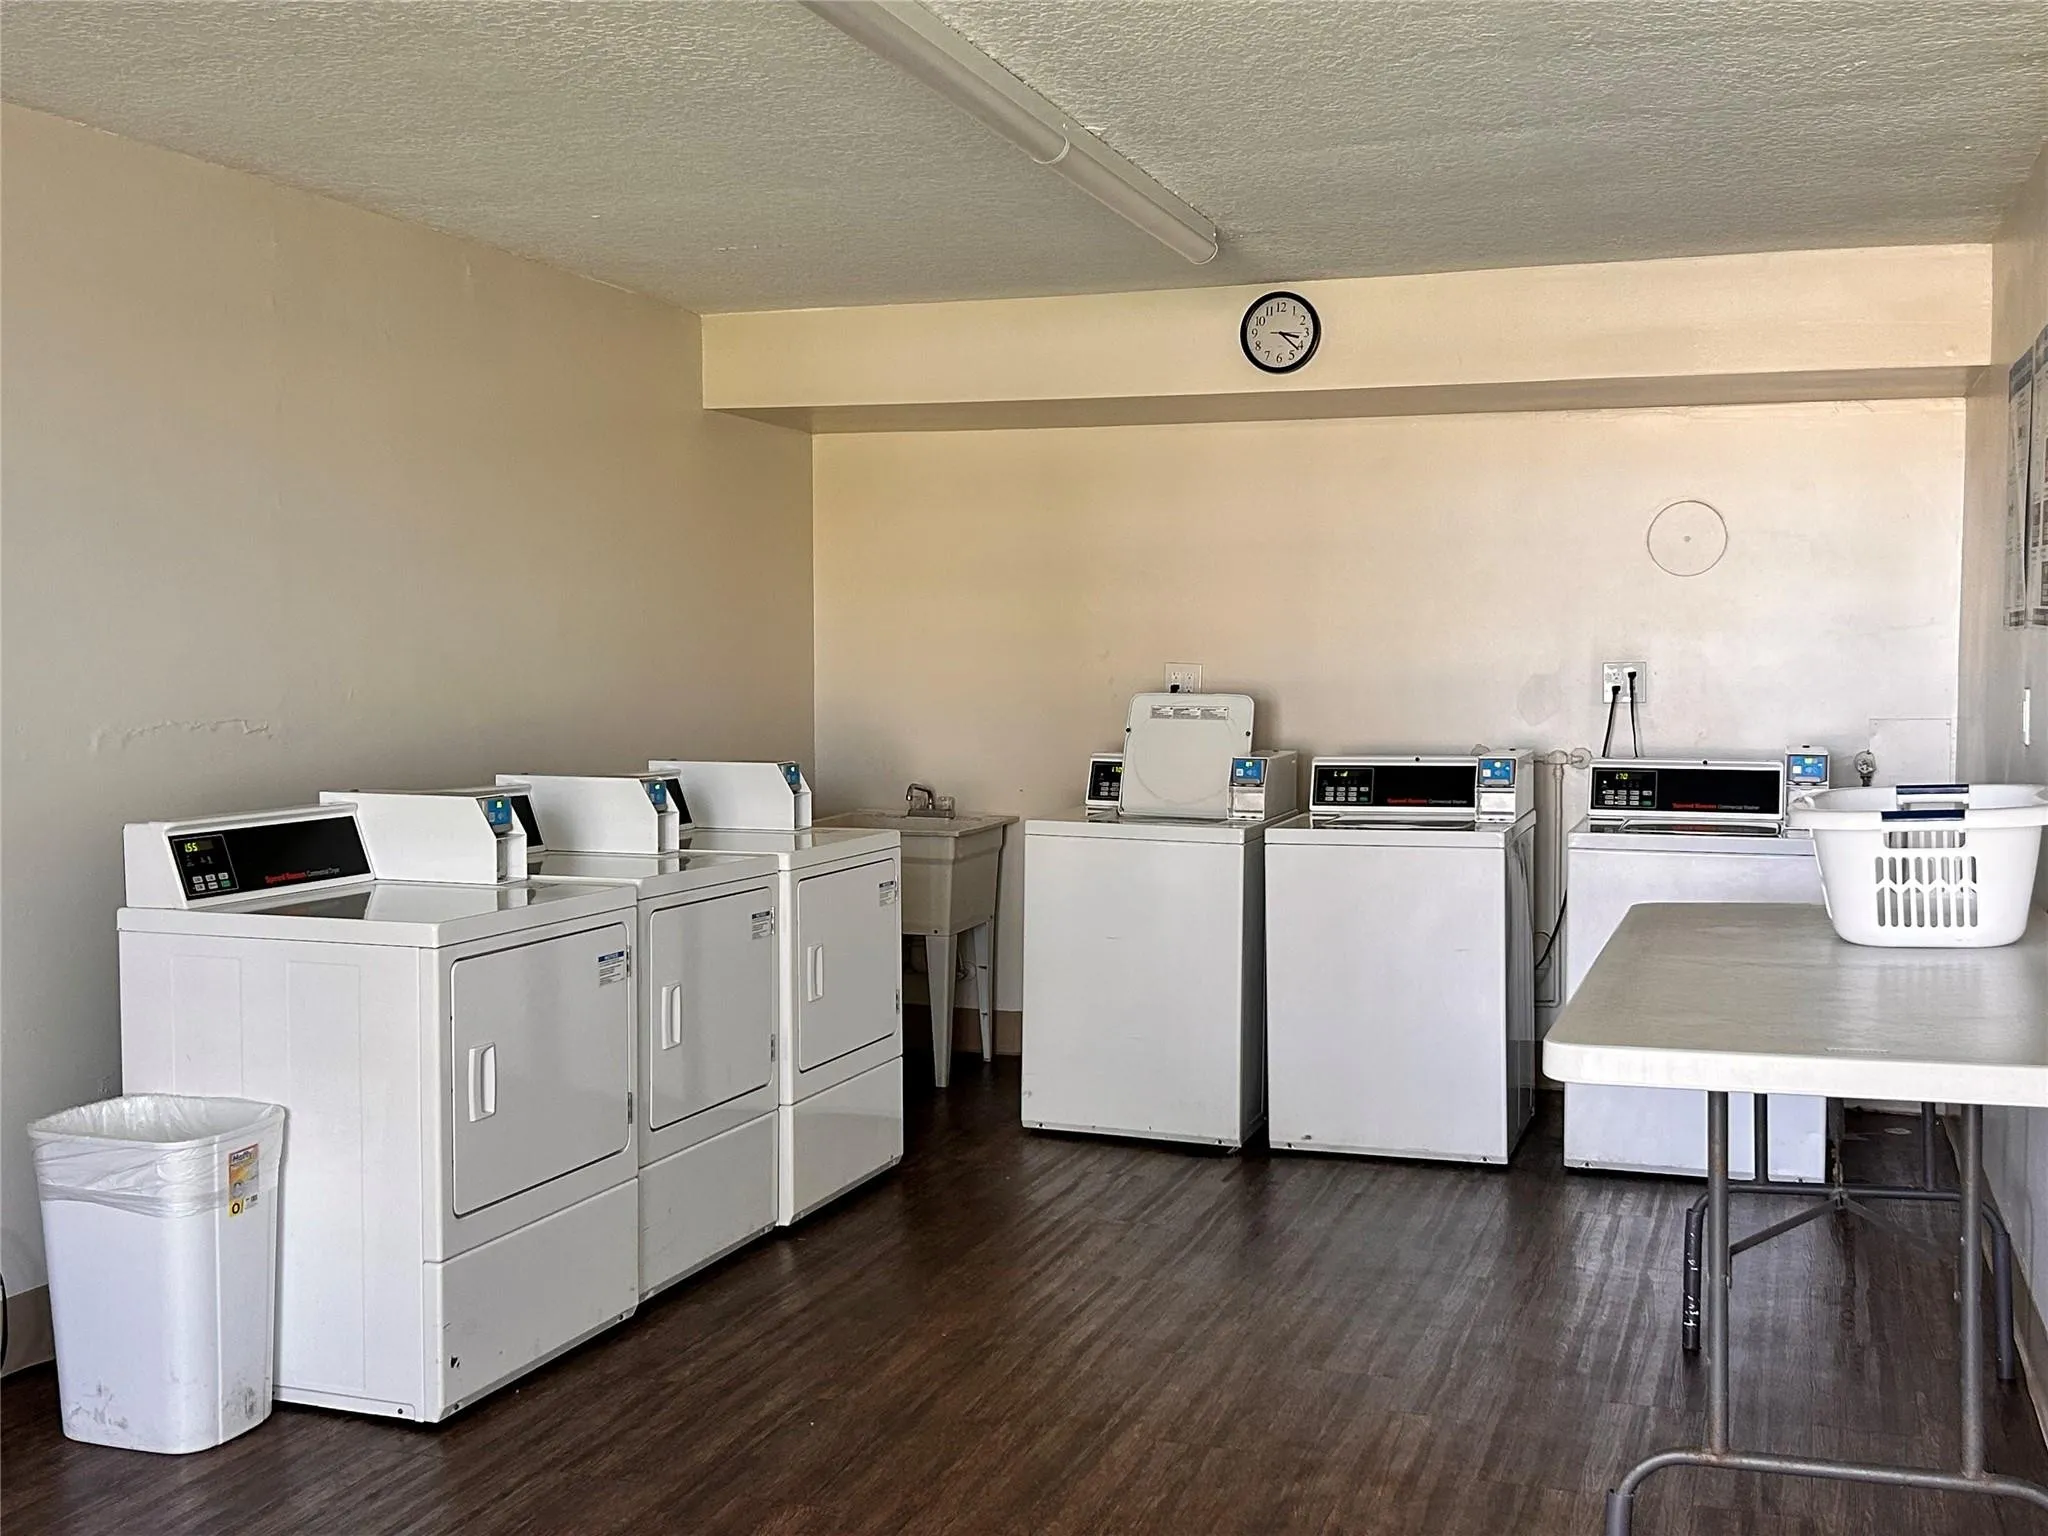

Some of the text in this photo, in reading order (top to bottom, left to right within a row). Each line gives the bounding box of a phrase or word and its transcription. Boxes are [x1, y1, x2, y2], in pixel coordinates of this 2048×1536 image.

[1266, 306, 1274, 317] 11
[1276, 301, 1287, 313] 12
[1256, 315, 1266, 327] 10
[1299, 315, 1306, 326] 2
[1251, 328, 1258, 339] 9
[1303, 327, 1310, 338] 3
[1255, 340, 1262, 352] 8
[1297, 340, 1304, 351] 4
[1264, 350, 1271, 361] 7
[1276, 353, 1283, 364] 6
[1288, 349, 1296, 361] 5
